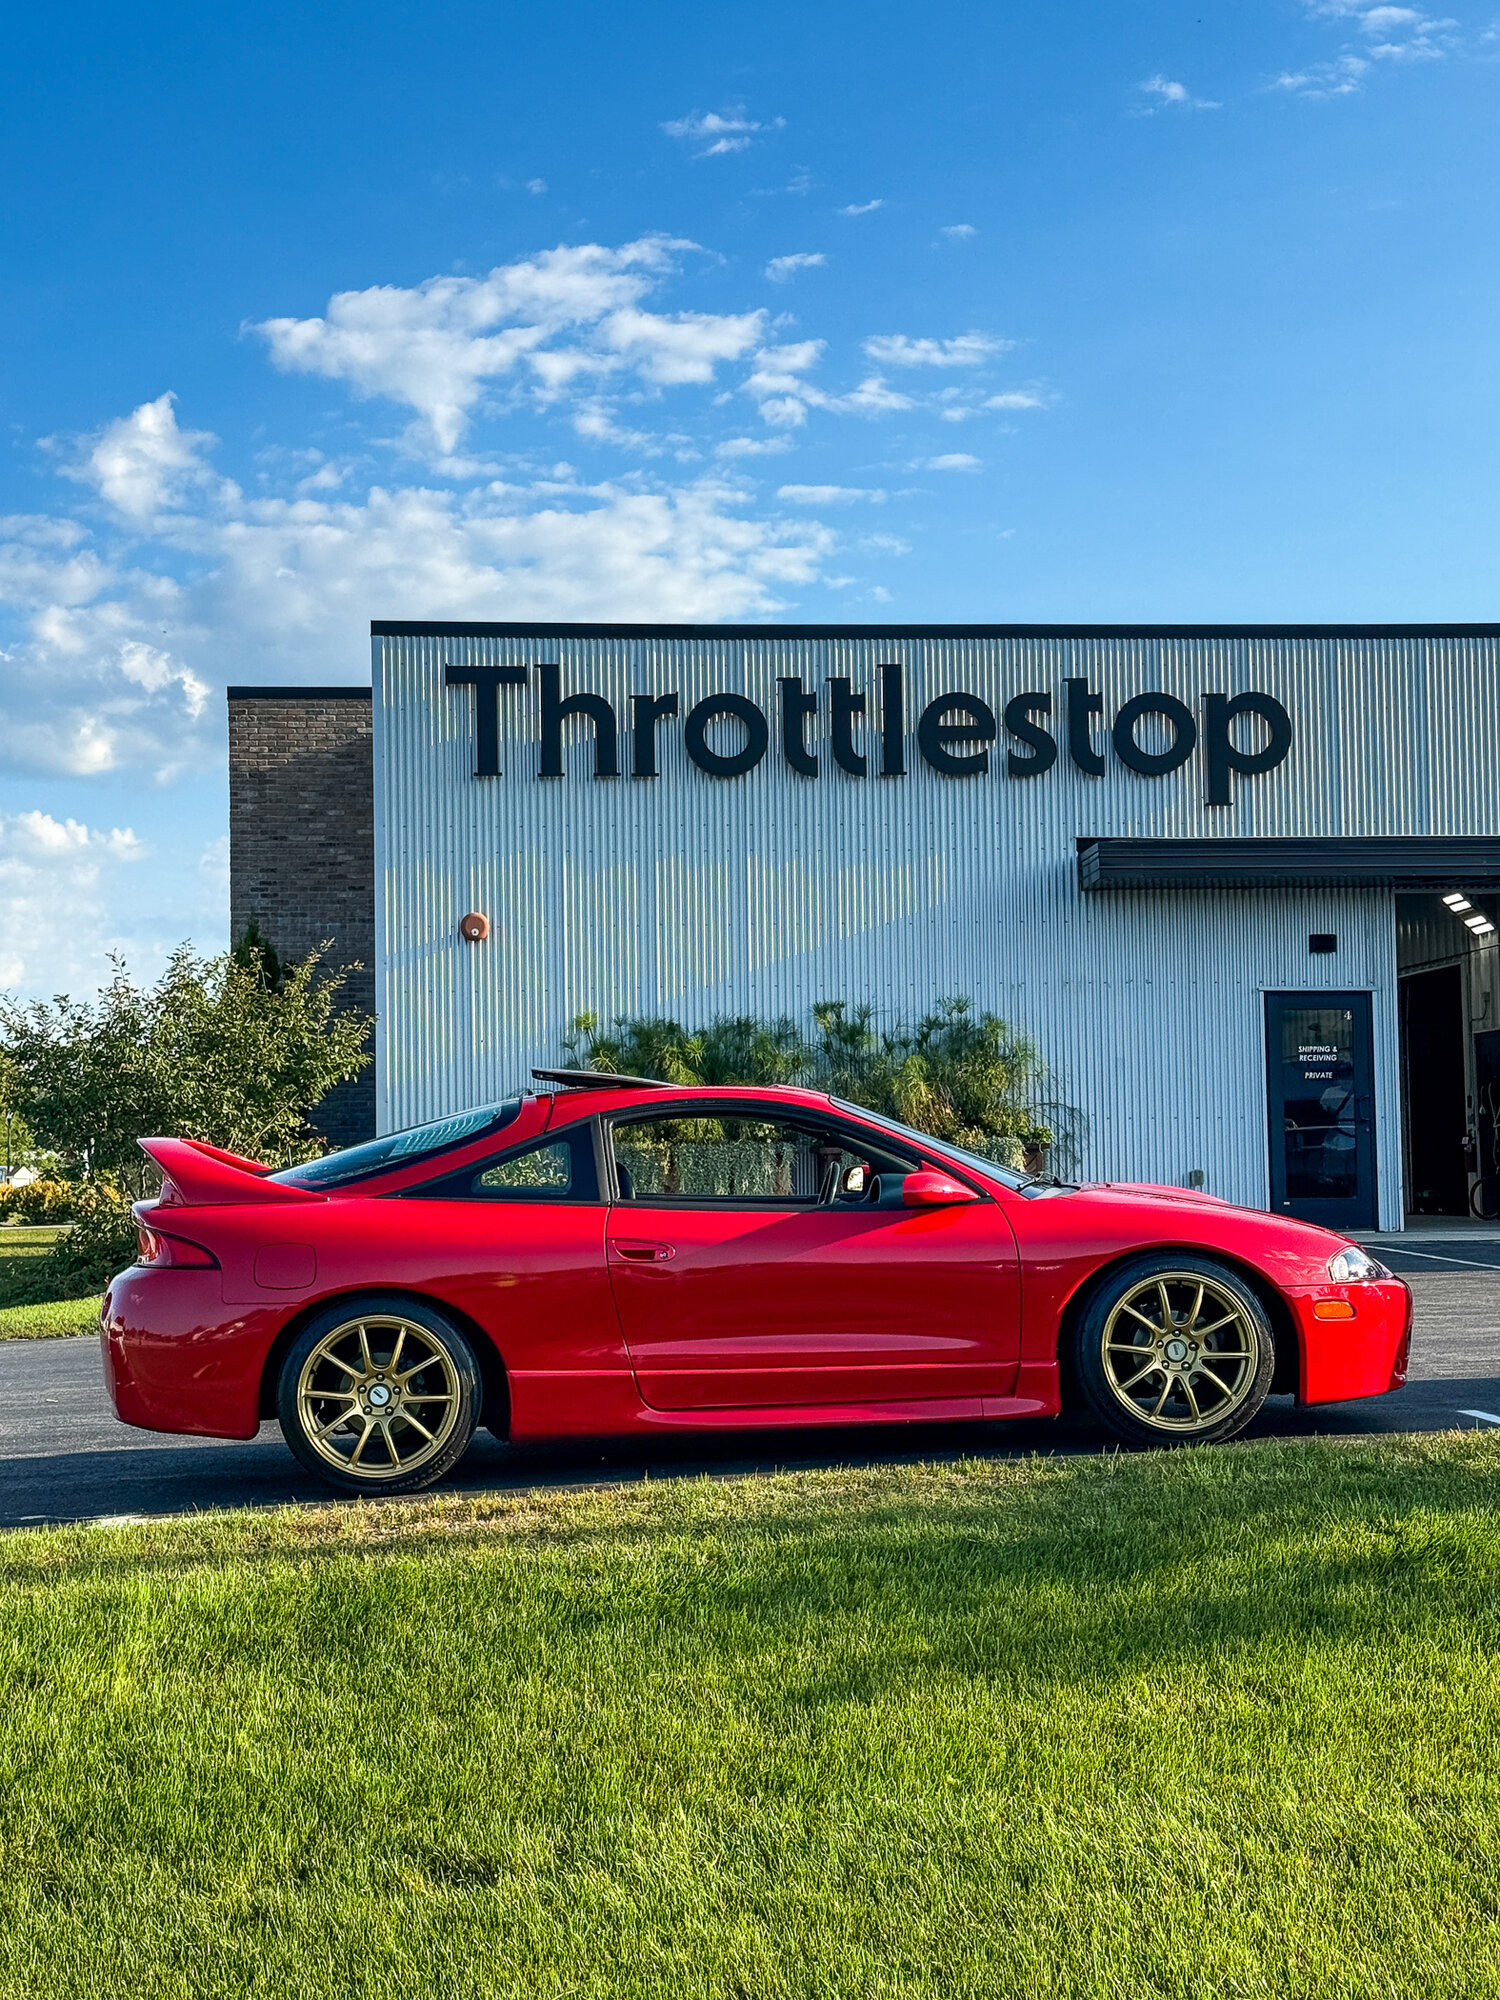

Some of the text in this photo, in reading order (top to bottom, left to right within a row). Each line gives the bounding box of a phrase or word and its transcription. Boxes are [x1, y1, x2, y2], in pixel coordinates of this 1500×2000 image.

[445, 663, 1292, 807] Throttlestop
[1343, 1010, 1352, 1020] 4
[1298, 1045, 1338, 1053] SHIPPING &
[1299, 1054, 1338, 1062] RECEIVING
[1304, 1071, 1333, 1079] PRIVATE
